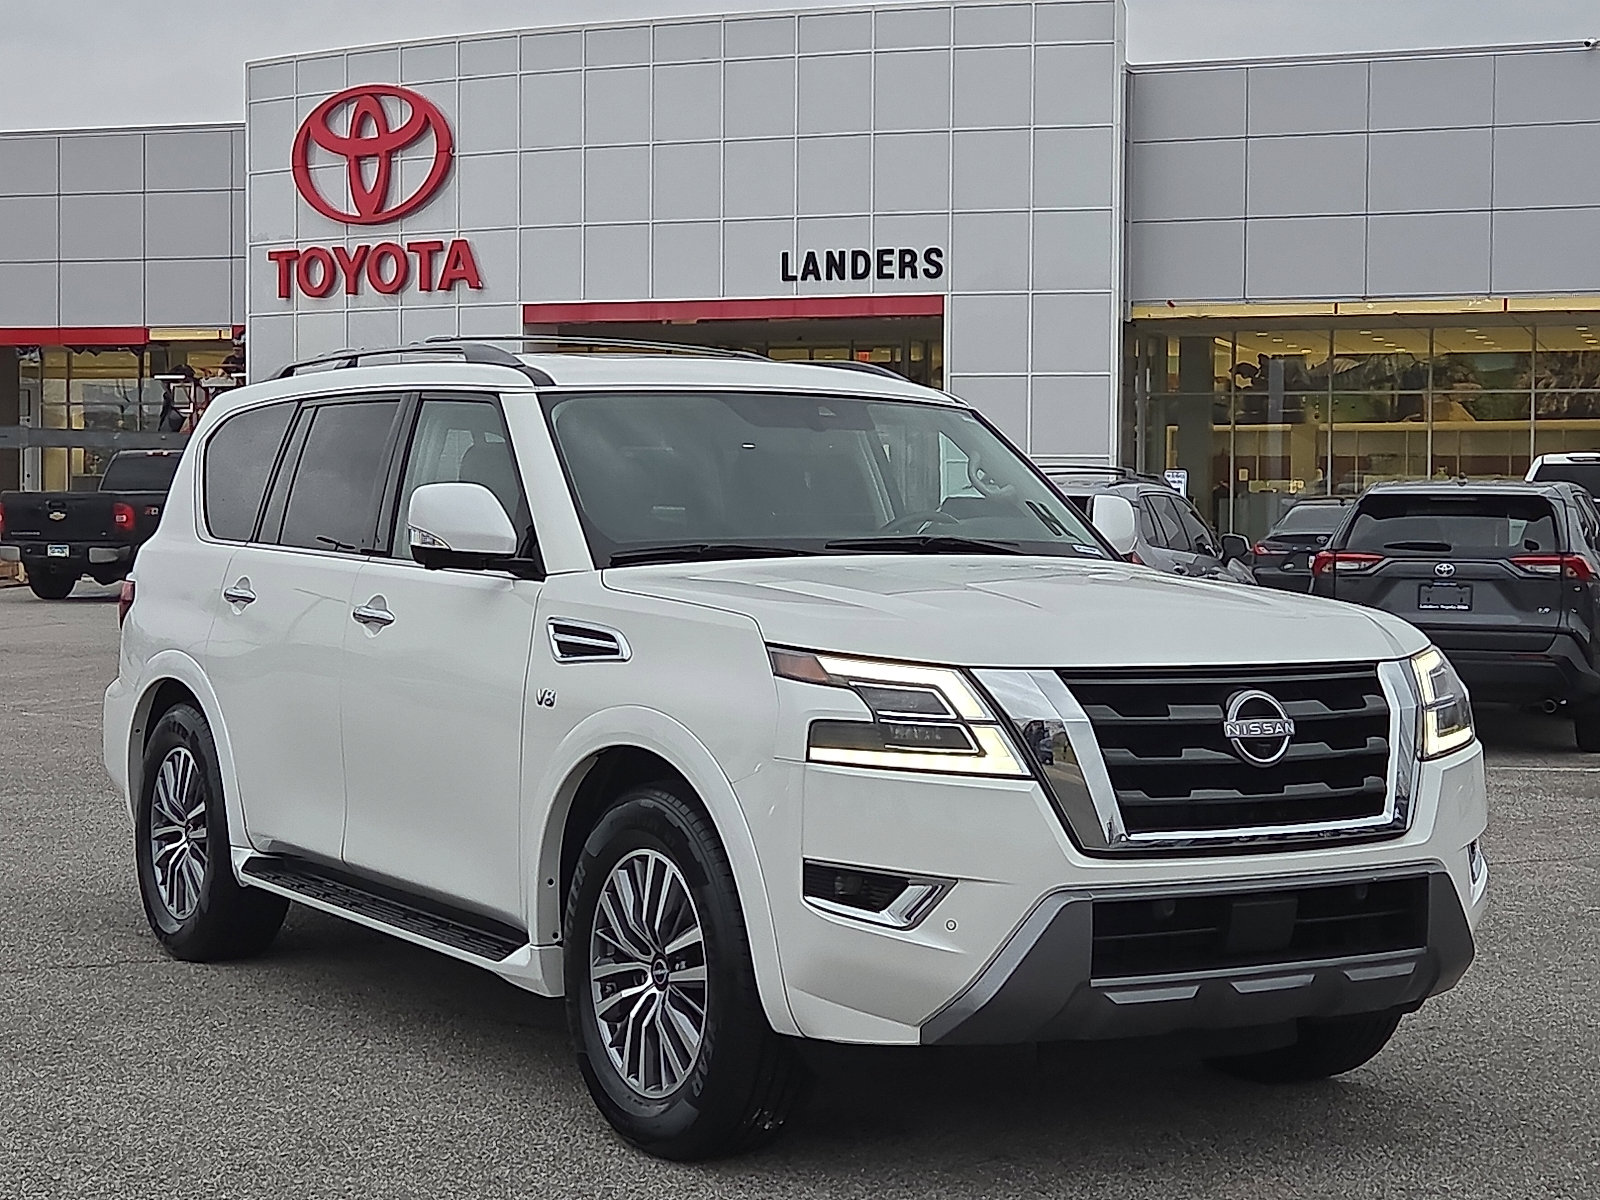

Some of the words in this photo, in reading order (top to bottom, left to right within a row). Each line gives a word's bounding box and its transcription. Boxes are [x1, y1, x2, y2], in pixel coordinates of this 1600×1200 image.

[267, 239, 483, 299] TOYOTA
[781, 247, 944, 282] LANDERS
[535, 688, 557, 708] V8
[1226, 722, 1295, 736] NISSAN
